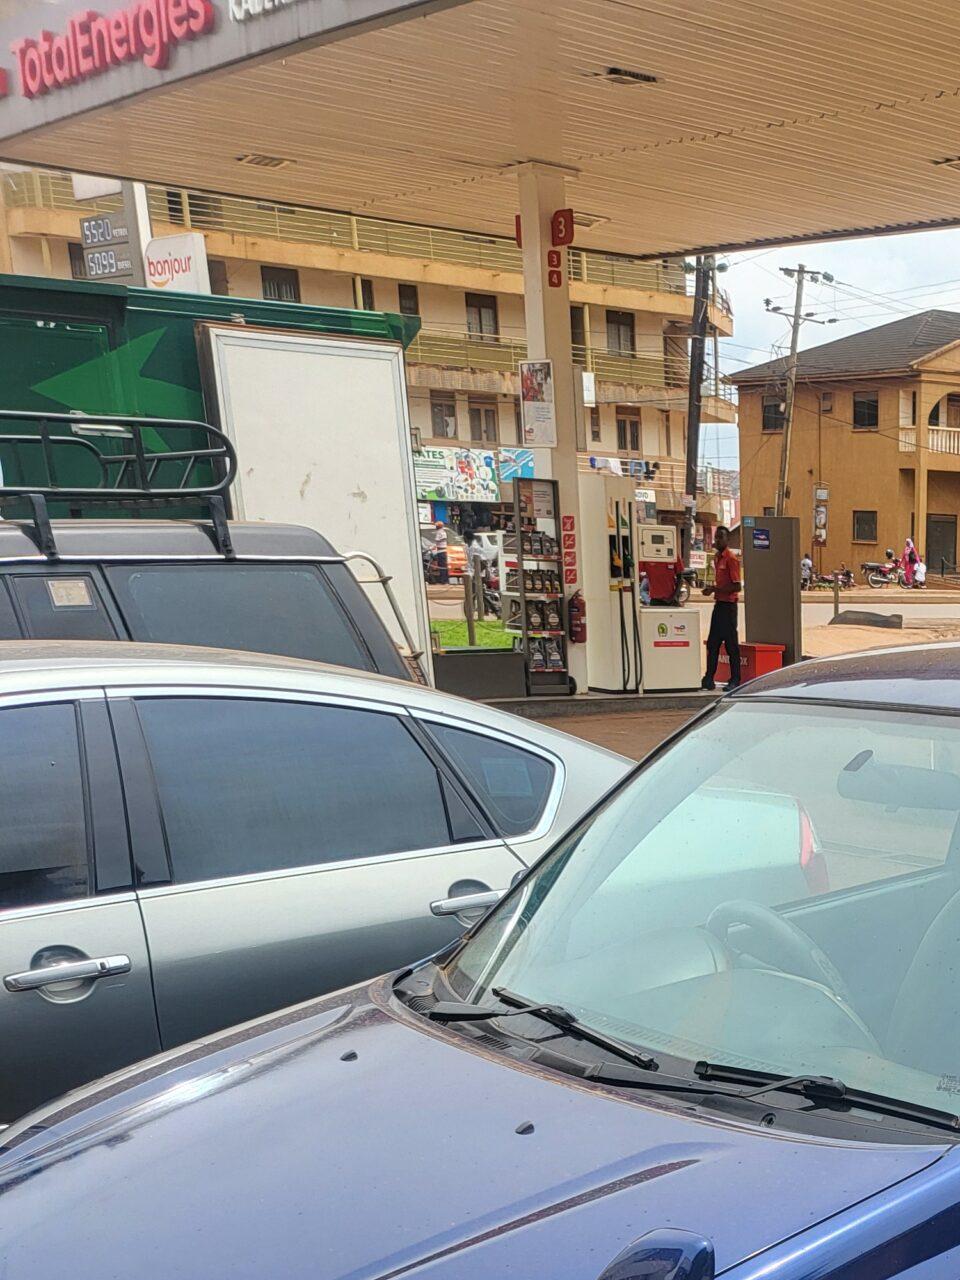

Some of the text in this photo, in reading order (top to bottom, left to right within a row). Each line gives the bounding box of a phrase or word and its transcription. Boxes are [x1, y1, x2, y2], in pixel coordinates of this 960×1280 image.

[10, 0, 210, 98] TotalEnergies
[83, 219, 112, 243] 5520
[558, 217, 565, 237] 3
[88, 251, 116, 275] 5099
[146, 255, 191, 281] bonjour
[552, 254, 557, 265] 3
[552, 274, 558, 283] 4
